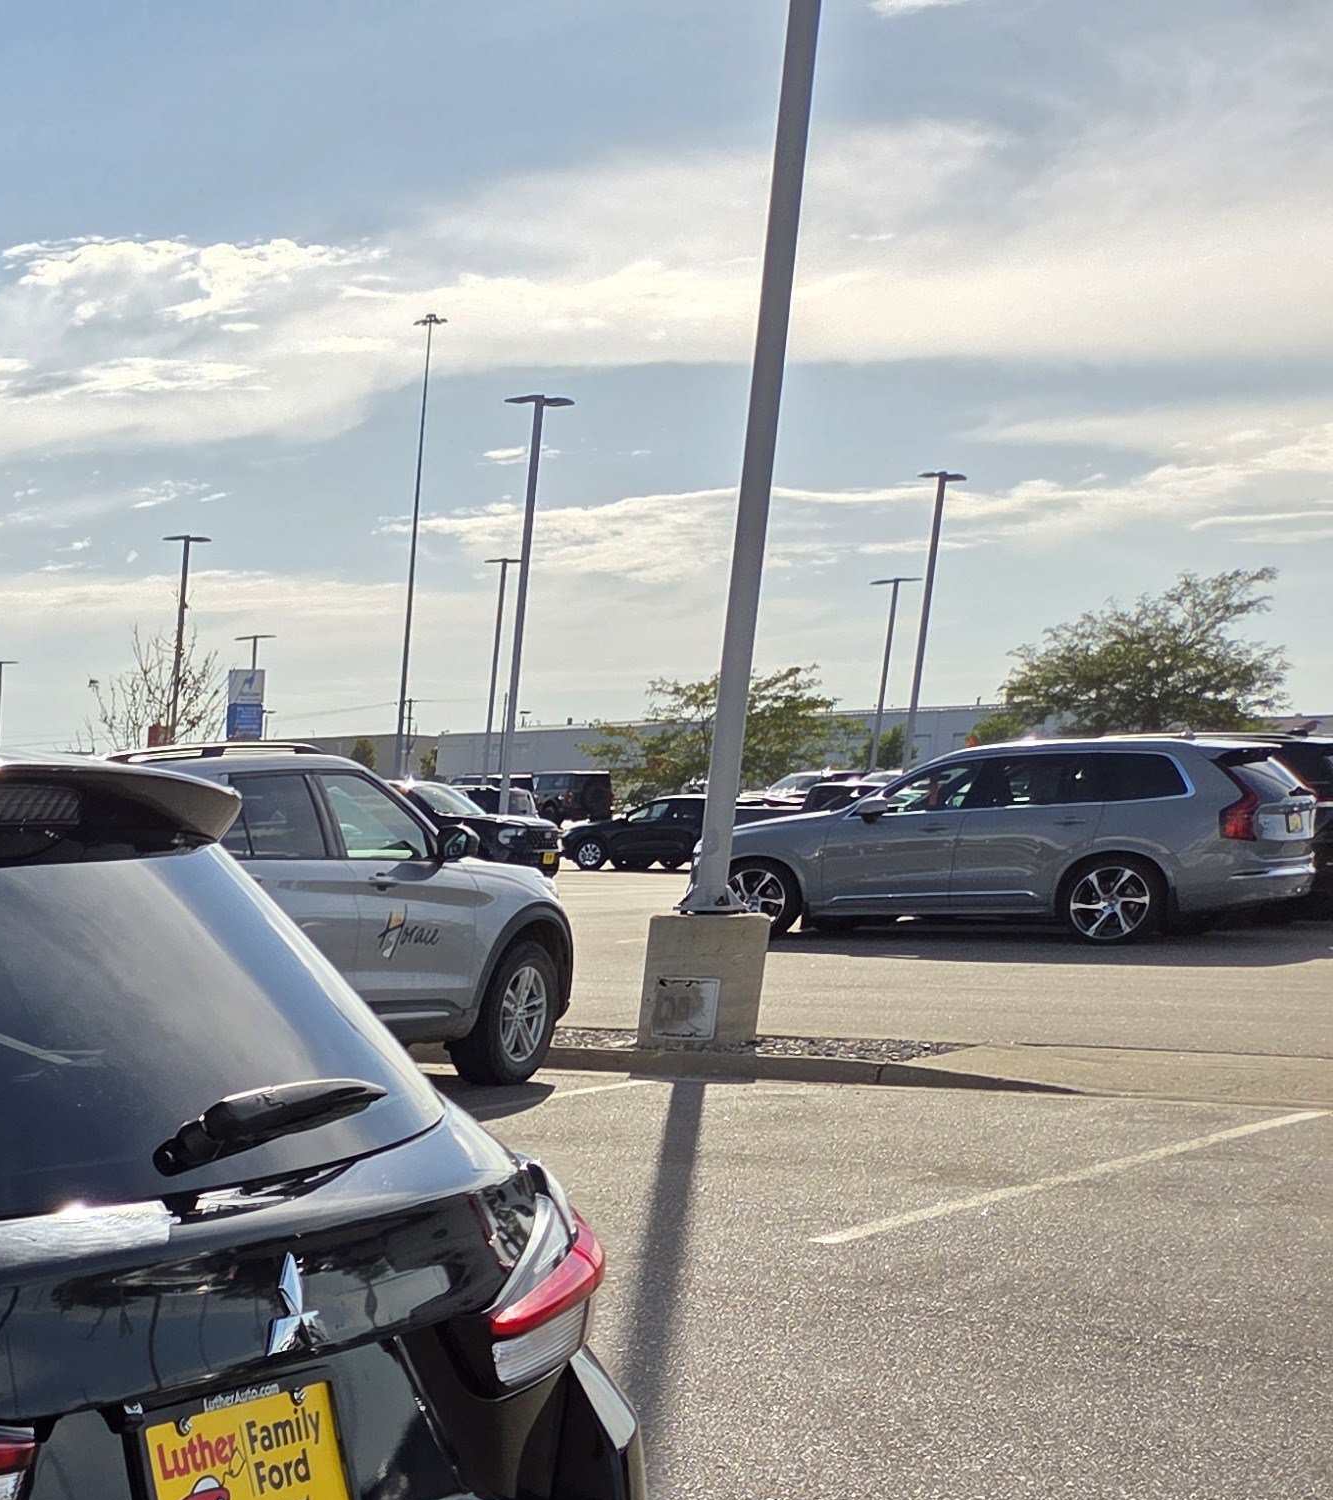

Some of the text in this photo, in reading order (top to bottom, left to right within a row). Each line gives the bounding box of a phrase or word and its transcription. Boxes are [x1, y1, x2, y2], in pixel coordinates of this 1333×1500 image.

[377, 903, 440, 961] Horace
[203, 1383, 280, 1413] LutherAuto.com
[156, 1407, 320, 1481] Luther Family
[254, 1448, 311, 1495] Ford
